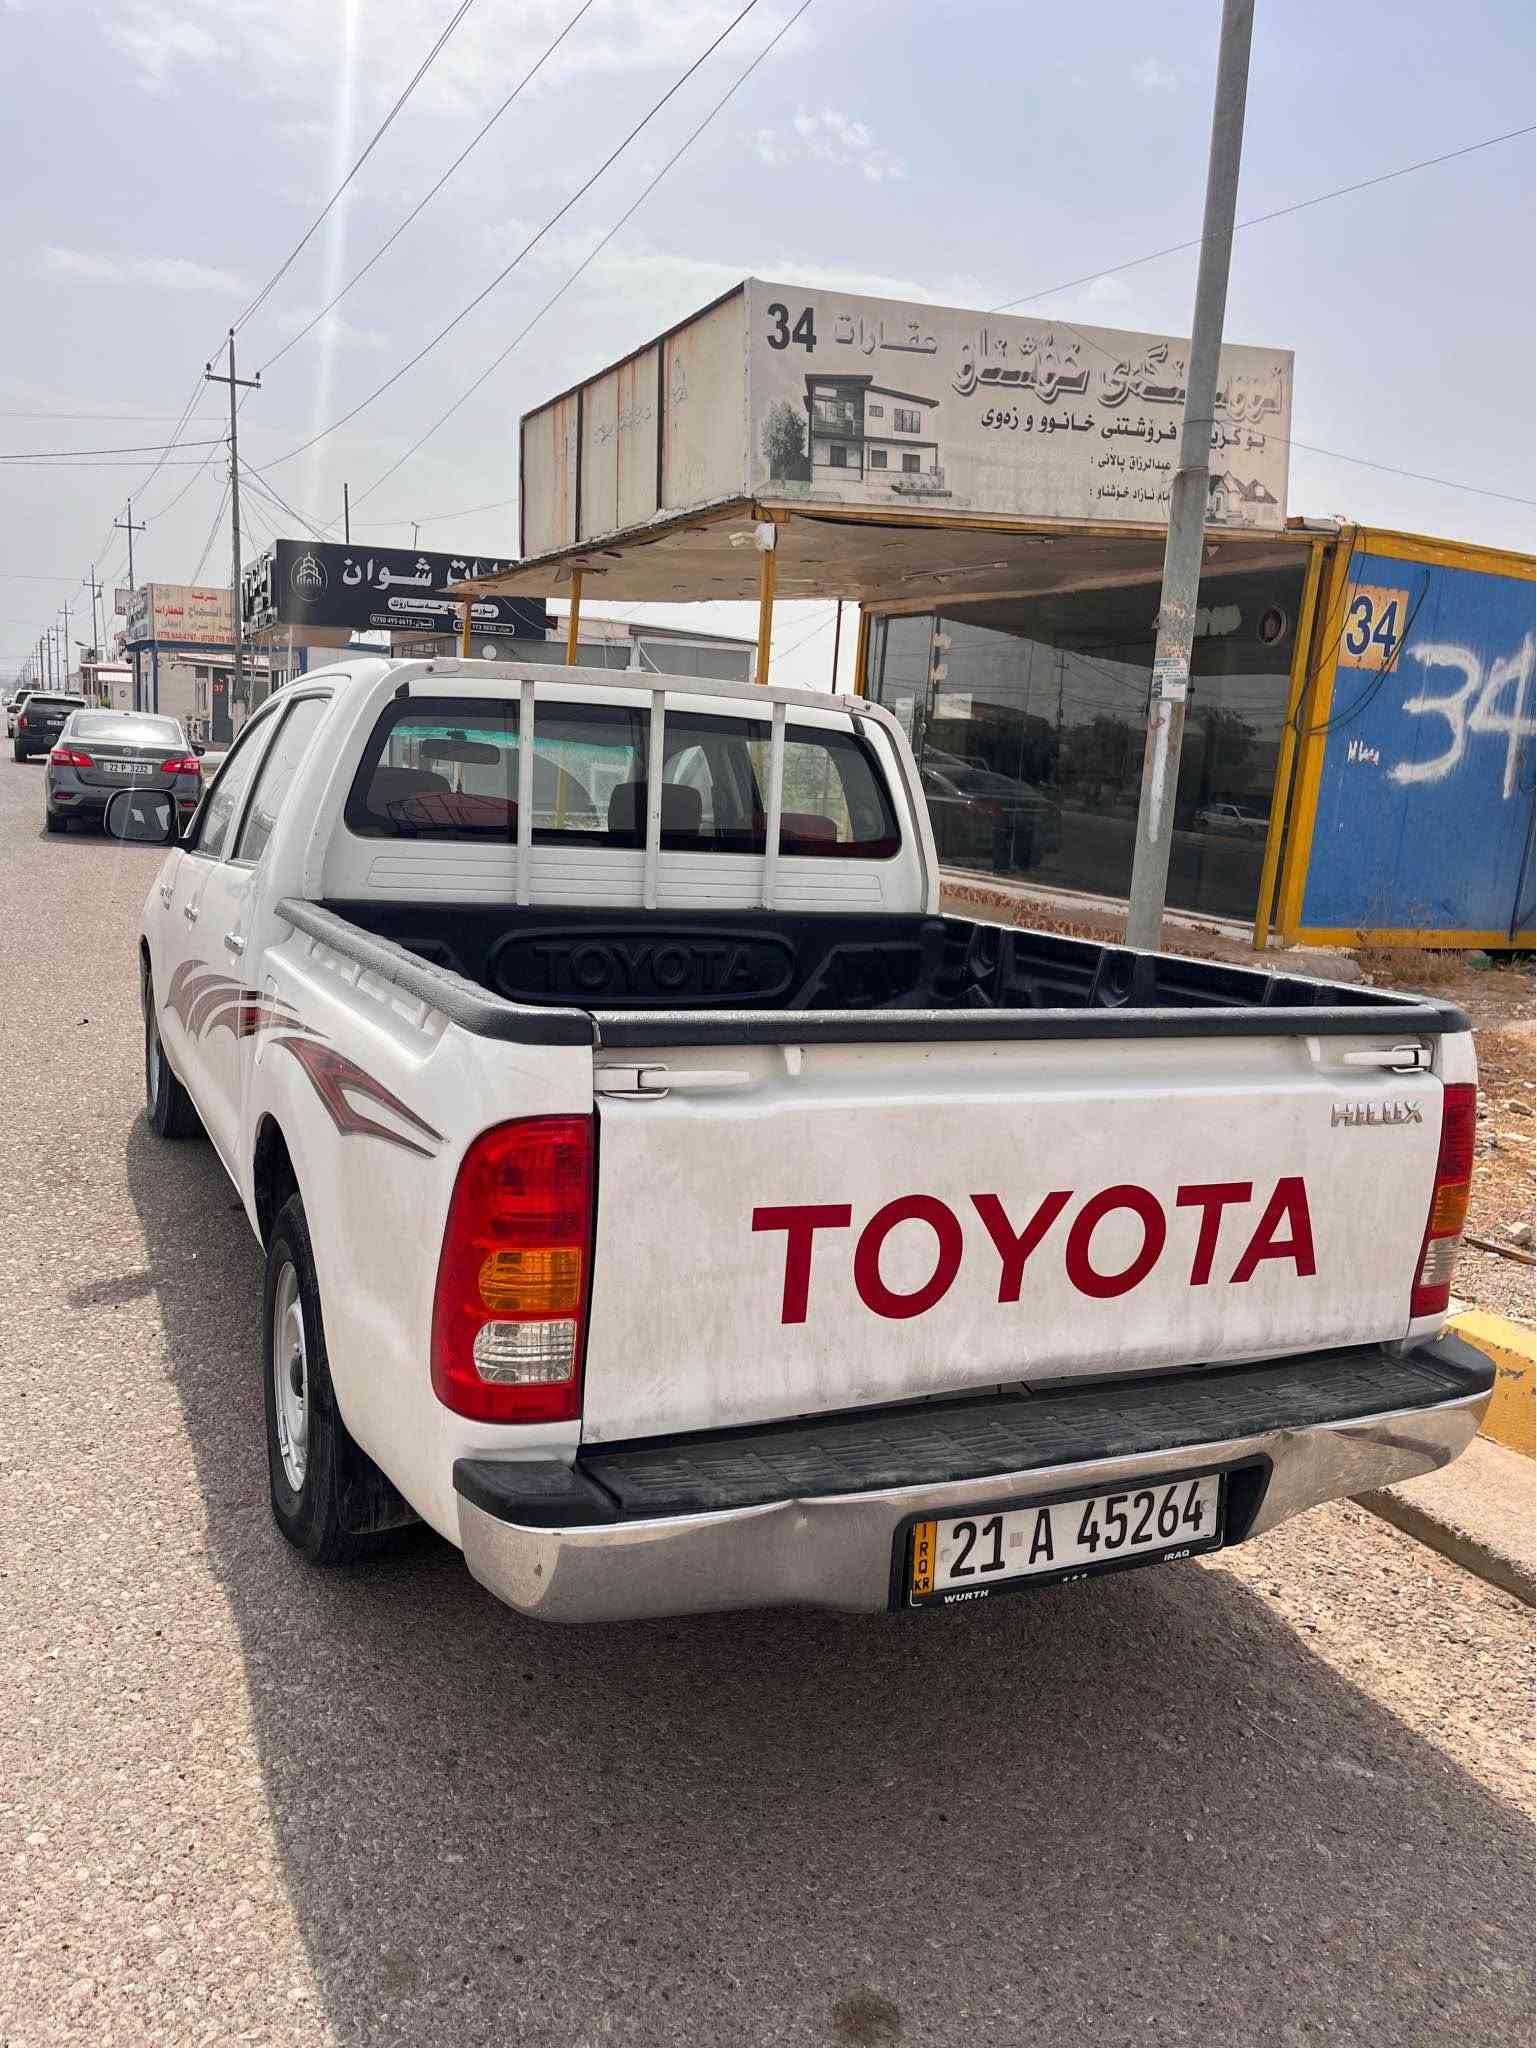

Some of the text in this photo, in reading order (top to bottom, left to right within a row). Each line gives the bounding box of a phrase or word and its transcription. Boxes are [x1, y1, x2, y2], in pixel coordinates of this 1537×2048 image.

[766, 303, 818, 353] 34
[832, 311, 940, 357] عقارات
[342, 556, 433, 590] شوان
[1346, 595, 1400, 658] 34
[1388, 631, 1536, 800] 34
[534, 942, 750, 986] TOYOTA
[1330, 1100, 1425, 1128] HILUX
[751, 1176, 1317, 1325] TOYOTA
[950, 1481, 1204, 1578] 21 A 45264
[1163, 1548, 1190, 1562] IRAQ
[914, 1577, 930, 1592] KR
[944, 1588, 990, 1604] WURTH
